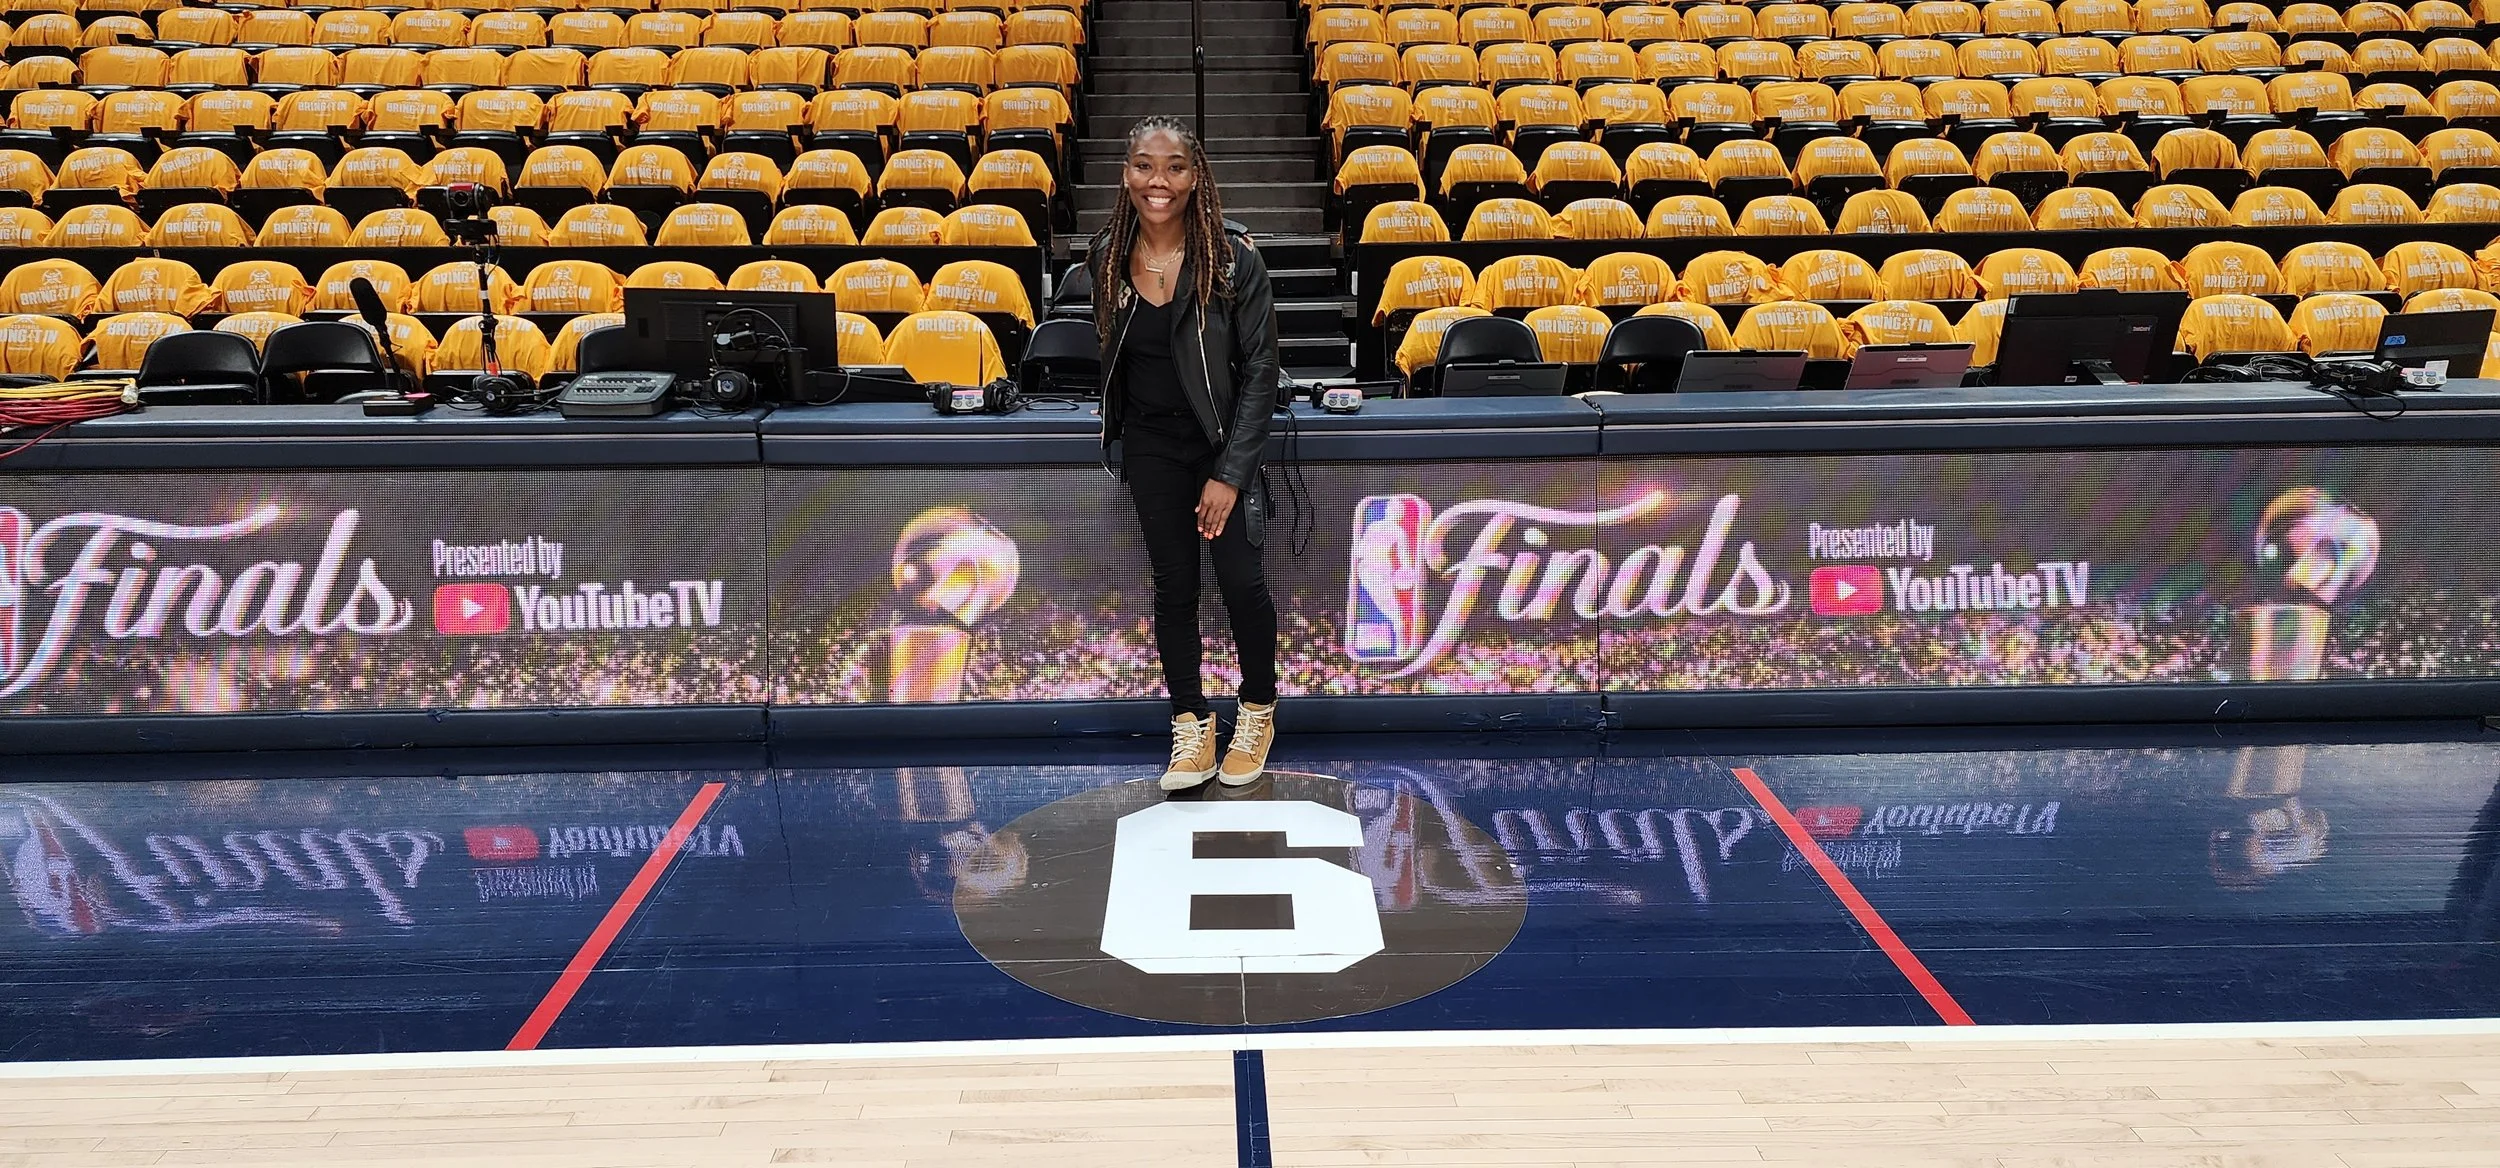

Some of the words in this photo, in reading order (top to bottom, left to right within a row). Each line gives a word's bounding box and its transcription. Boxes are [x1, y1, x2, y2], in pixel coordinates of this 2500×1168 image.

[0, 505, 413, 697] Finals
[433, 536, 536, 577] Presented
[538, 536, 563, 578] by
[1380, 490, 1789, 679] Finals
[1809, 518, 1906, 560] Presented
[1908, 518, 1934, 562] by
[1100, 801, 1385, 974] 6
